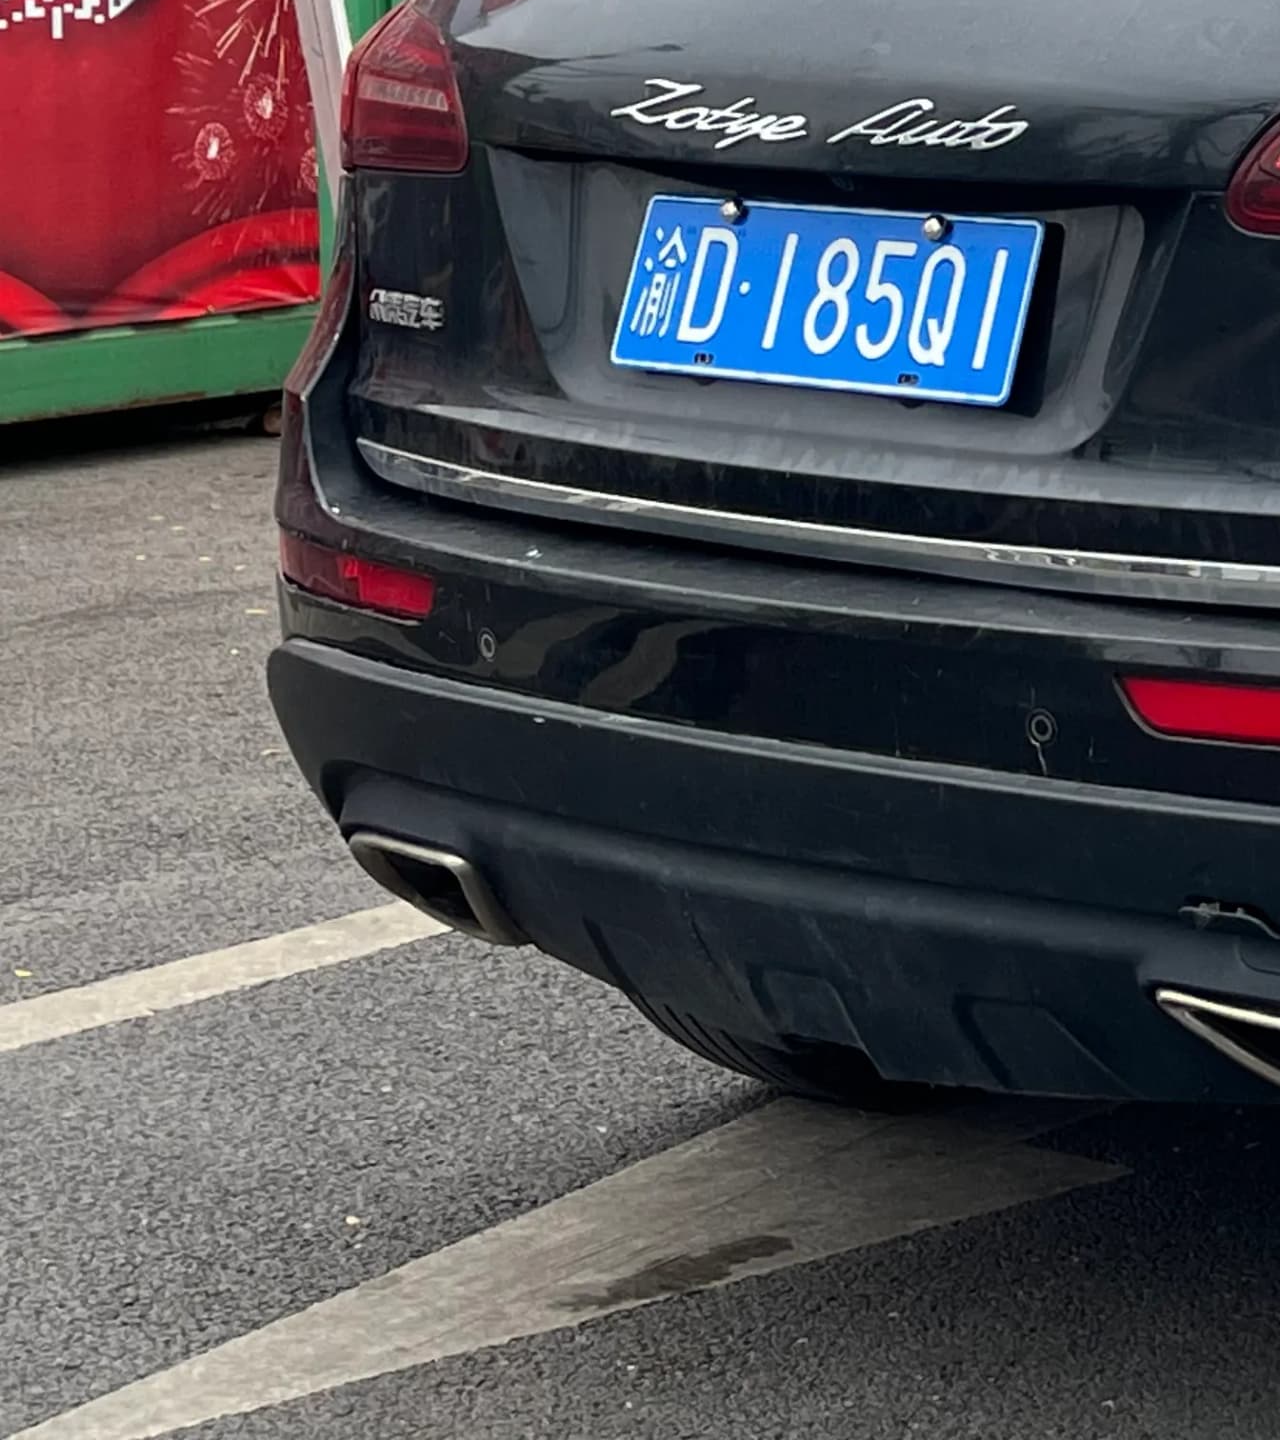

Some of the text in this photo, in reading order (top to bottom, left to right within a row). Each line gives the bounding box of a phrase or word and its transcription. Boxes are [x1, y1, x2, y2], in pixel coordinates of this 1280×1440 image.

[611, 78, 1031, 150] Zotye Auto
[630, 226, 1009, 371] 渝D·185Q1
